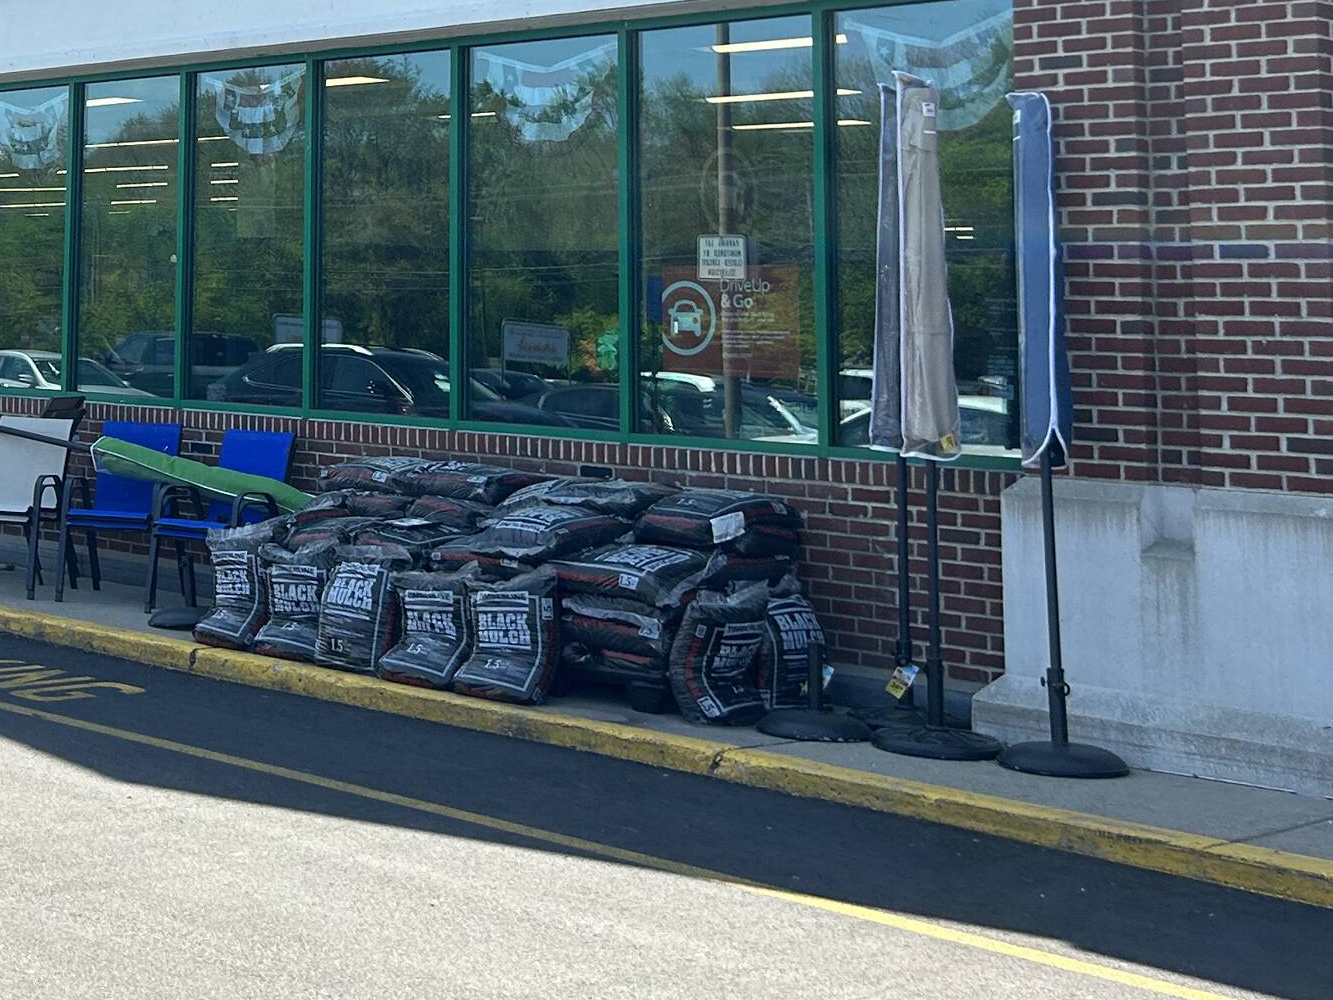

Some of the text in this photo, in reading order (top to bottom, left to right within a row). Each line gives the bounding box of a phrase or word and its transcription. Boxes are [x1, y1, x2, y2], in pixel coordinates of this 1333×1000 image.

[719, 278, 771, 297] DriveUp
[720, 293, 754, 309] & Go
[273, 584, 318, 602] BLACK
[333, 577, 374, 598] BLACK
[273, 597, 320, 612] MULCH
[326, 586, 373, 611] MULCH
[478, 612, 529, 630] BLACK
[773, 612, 822, 631] BLACK
[478, 630, 531, 645] MULCH
